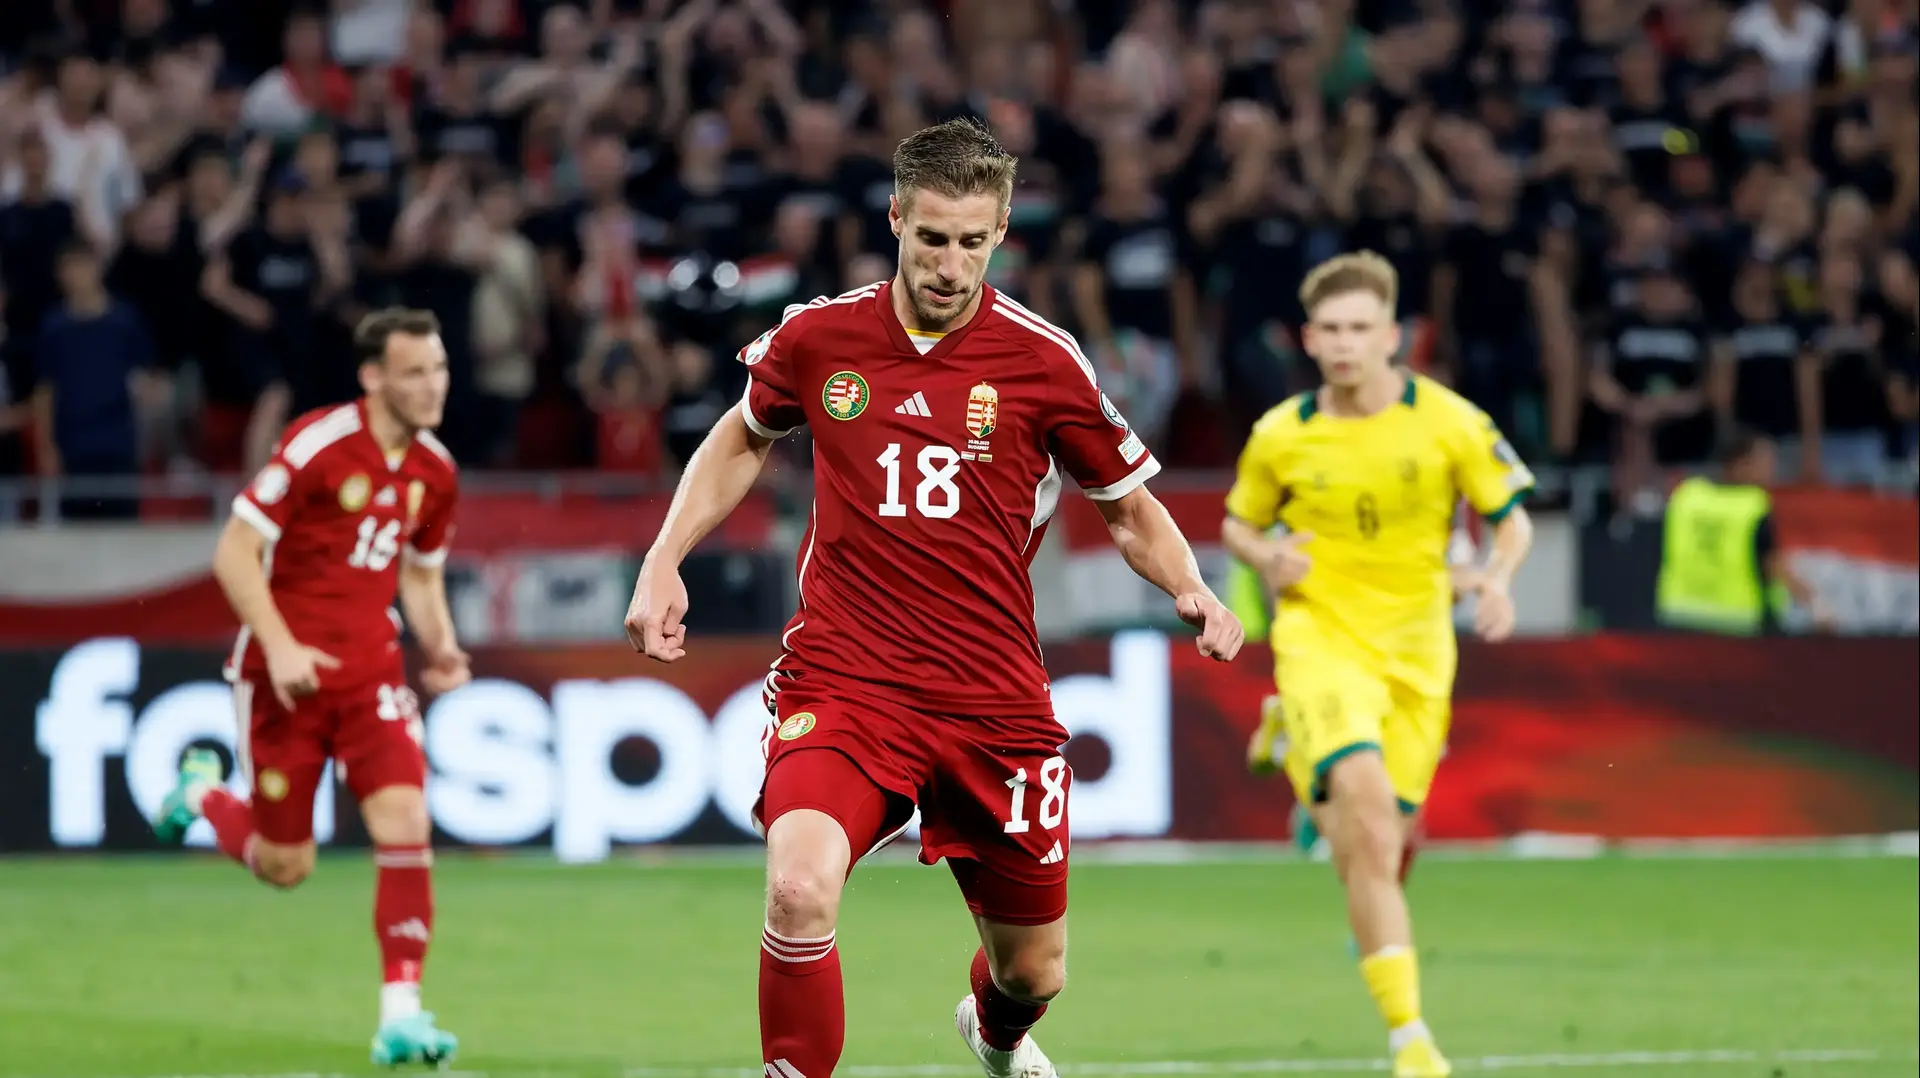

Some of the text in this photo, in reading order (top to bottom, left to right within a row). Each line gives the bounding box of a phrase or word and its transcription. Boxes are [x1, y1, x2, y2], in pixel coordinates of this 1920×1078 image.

[876, 443, 961, 519] 18
[347, 515, 401, 571] 16
[1003, 755, 1066, 834] 18
